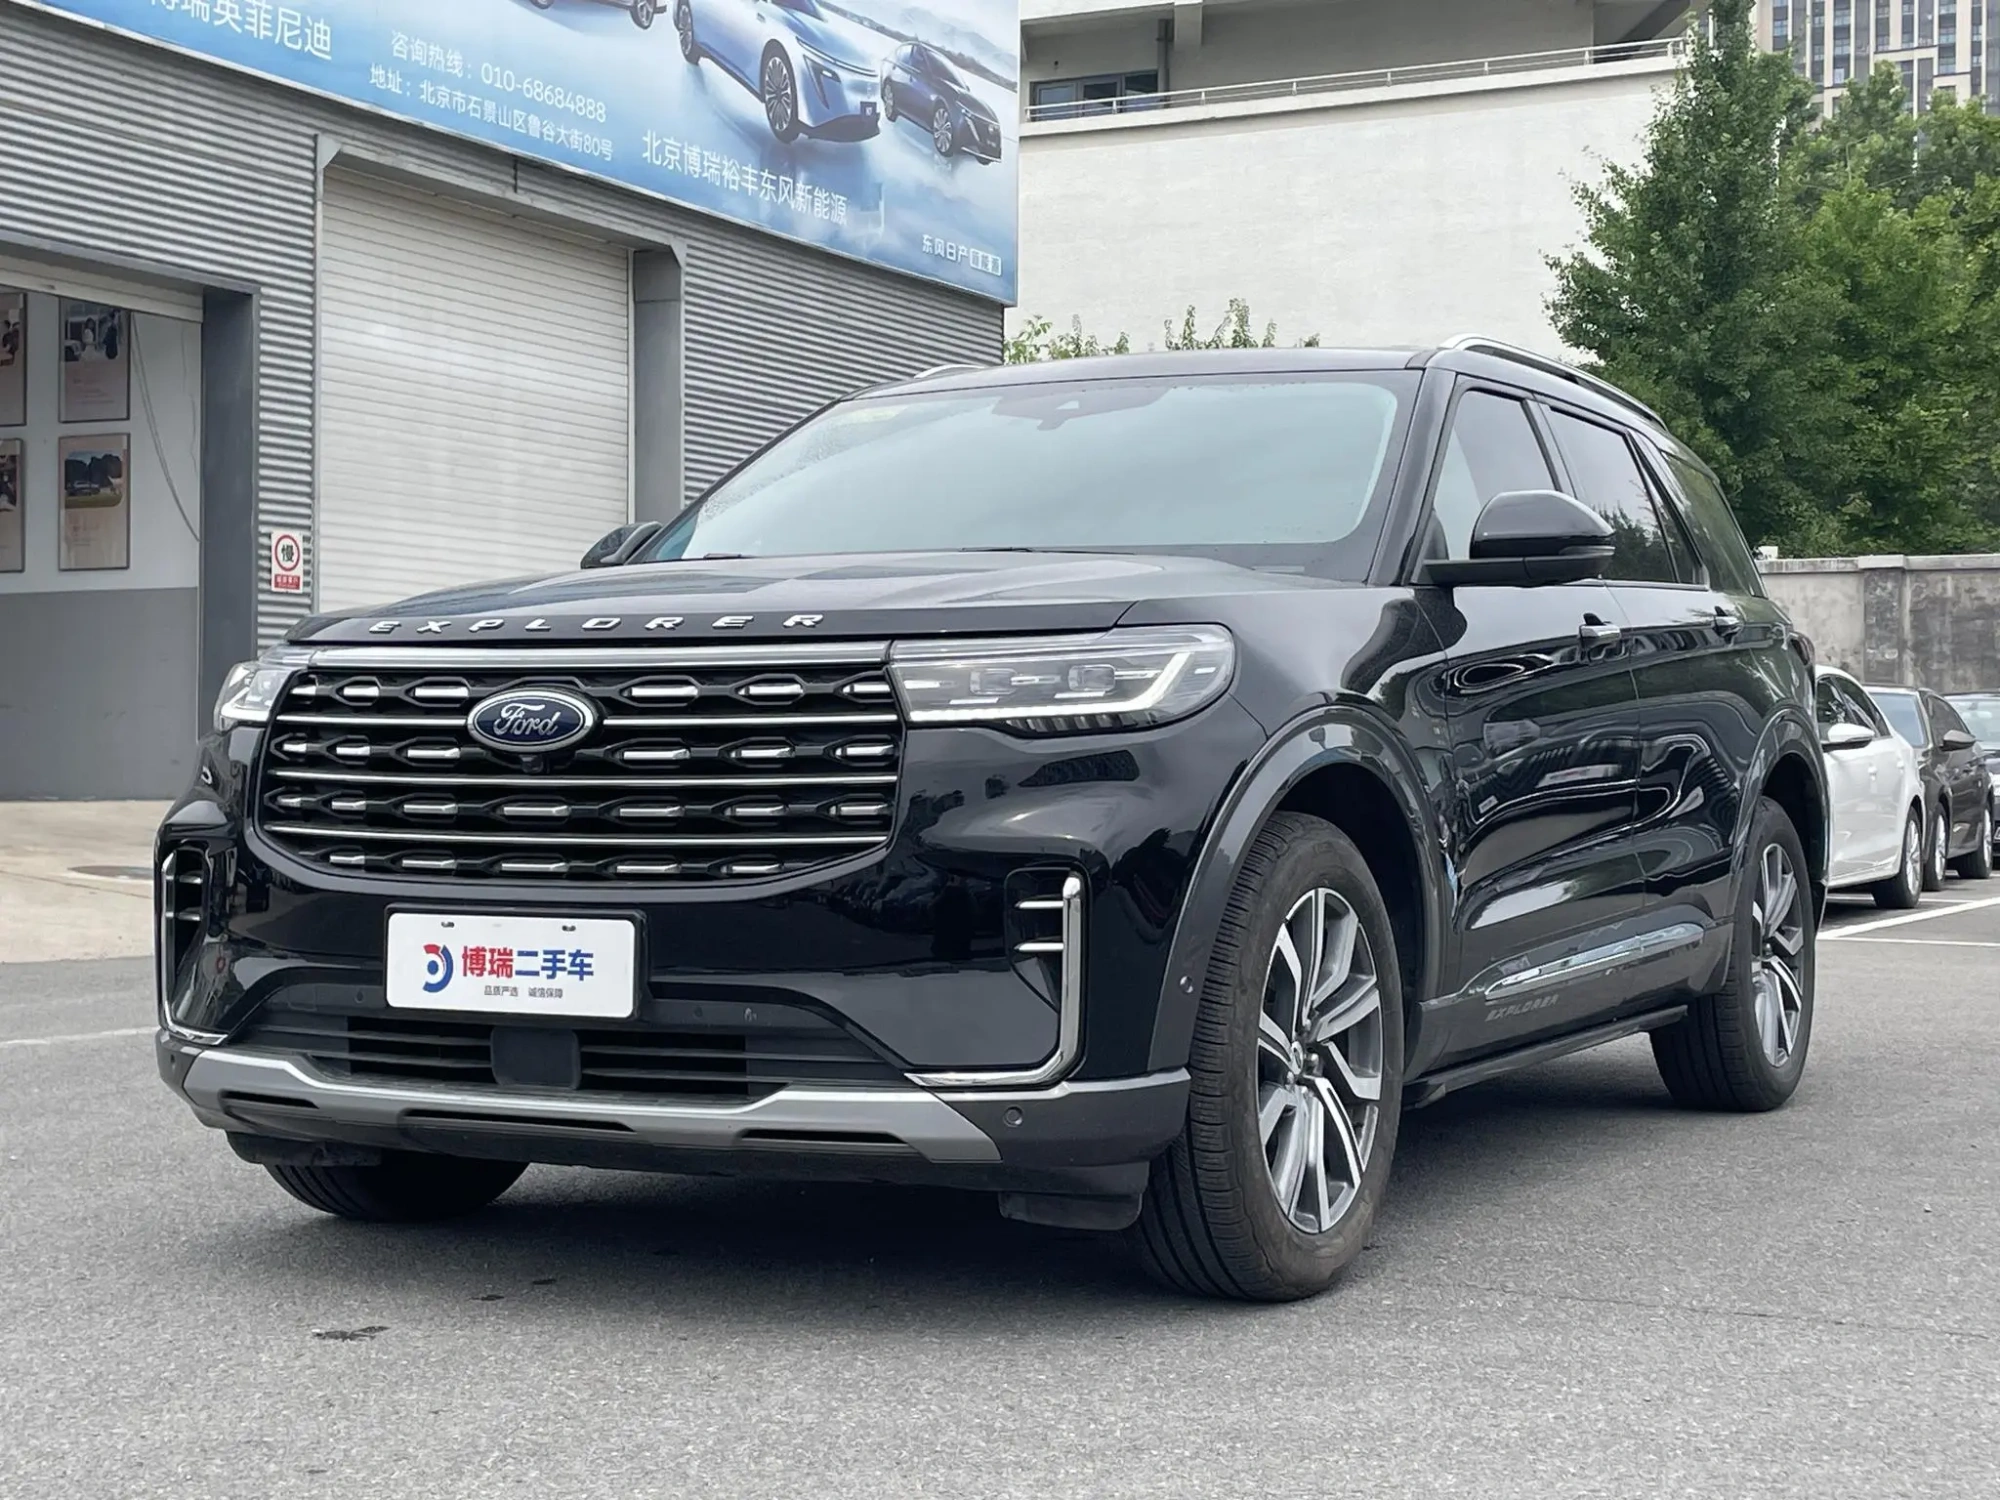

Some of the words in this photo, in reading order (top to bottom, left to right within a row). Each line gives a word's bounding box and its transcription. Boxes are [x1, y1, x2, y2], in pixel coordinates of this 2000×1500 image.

[642, 130, 848, 226] 北京博瑞裕丰东风新能源
[369, 614, 824, 633] EXPLORER
[493, 703, 561, 735] Ford
[461, 946, 594, 981] 博瑞二手车
